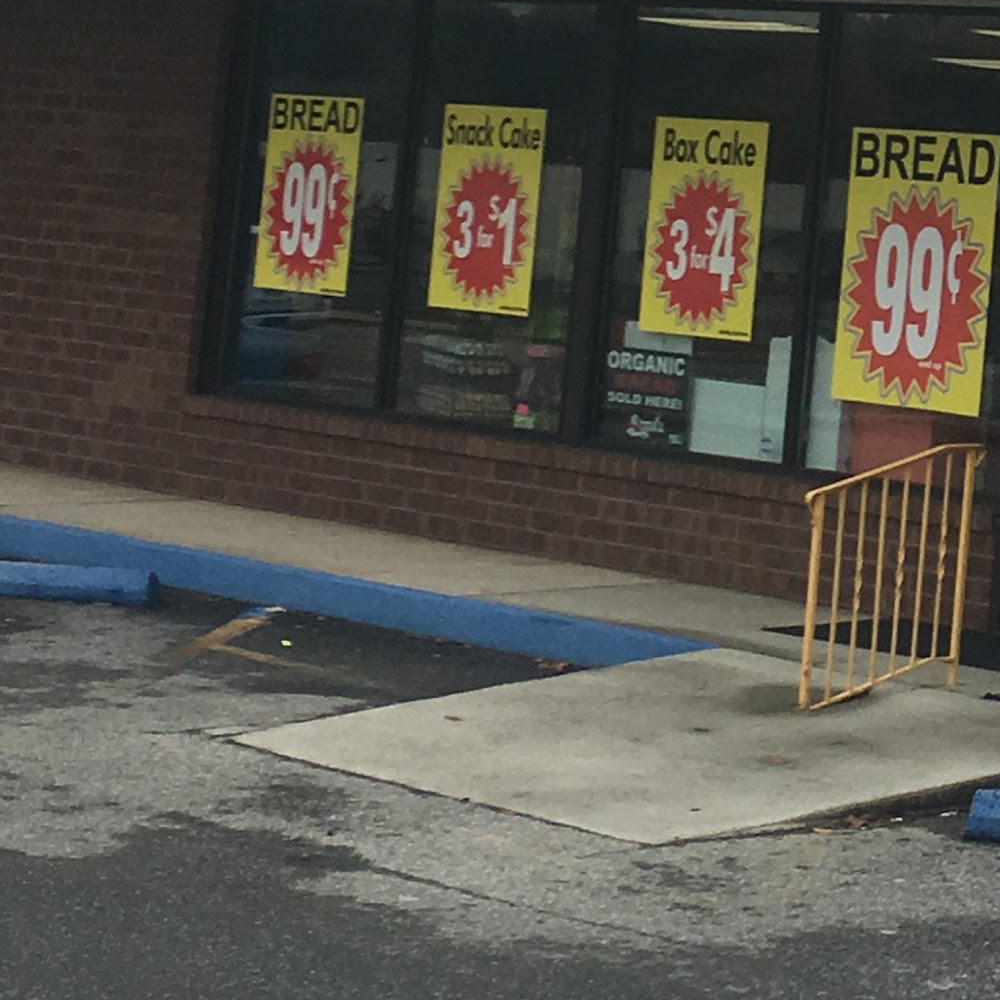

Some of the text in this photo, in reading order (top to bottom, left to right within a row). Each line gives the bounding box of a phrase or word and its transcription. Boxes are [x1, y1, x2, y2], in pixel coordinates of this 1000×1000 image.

[271, 97, 361, 134] BREAD
[447, 113, 541, 150] Snack Cake
[662, 127, 757, 167] Box Cake
[854, 132, 996, 186] BREAD
[453, 194, 518, 266] 3 for $1
[666, 205, 736, 292] 3 for $4
[607, 349, 687, 377] ORGANIC
[607, 390, 642, 405] SOLD
